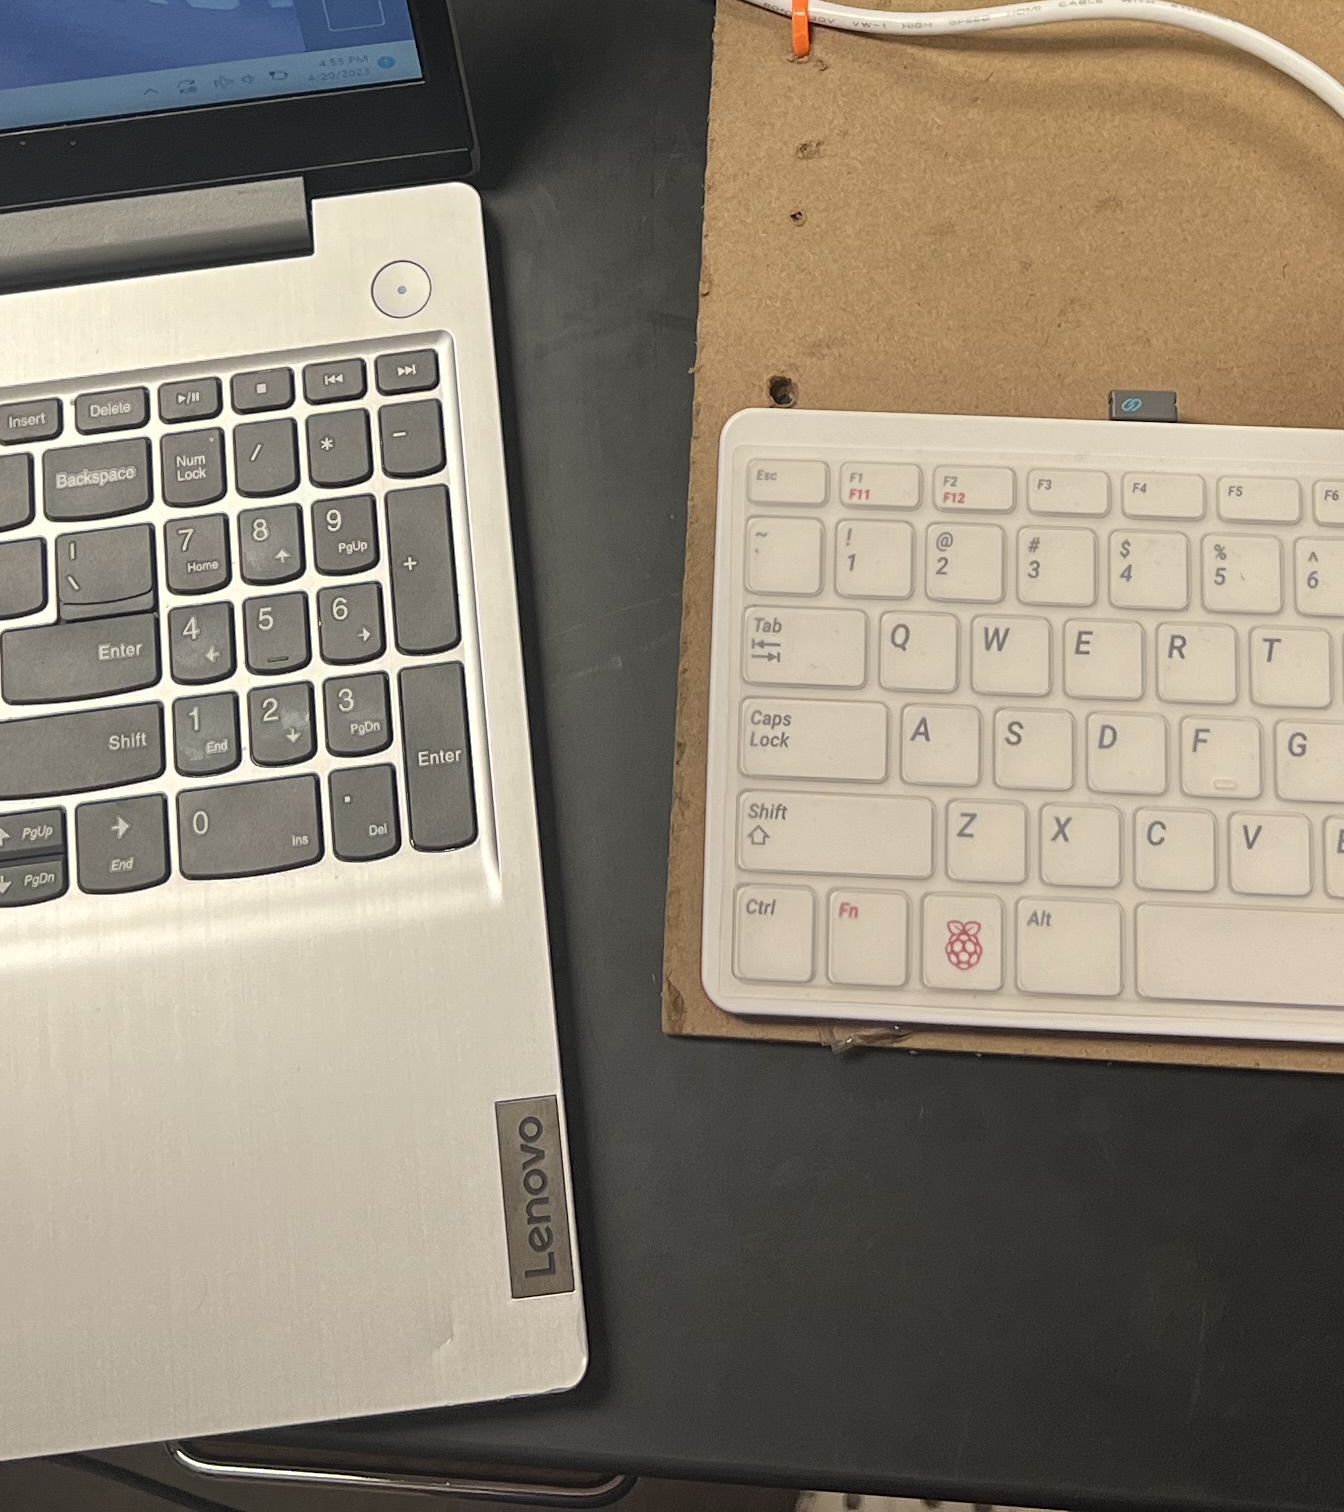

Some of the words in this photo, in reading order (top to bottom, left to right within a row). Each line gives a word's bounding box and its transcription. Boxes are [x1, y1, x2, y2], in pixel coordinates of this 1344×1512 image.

[348, 55, 369, 65] PM
[90, 402, 131, 417] Delete
[8, 412, 46, 429] Insert
[176, 455, 206, 468] Num
[55, 467, 135, 489] Backspace
[176, 466, 207, 482] Lock
[756, 468, 778, 481] Esc
[849, 471, 864, 484] F1
[942, 475, 958, 488] F2
[1037, 478, 1053, 491] F3
[1132, 482, 1147, 494] F4
[1227, 485, 1243, 497] F5
[848, 488, 871, 501] F11
[943, 491, 966, 504] F12
[1323, 489, 1340, 502] F6
[338, 540, 368, 555] PgUp
[187, 561, 219, 573] Home
[754, 617, 783, 634] Tab
[98, 643, 143, 661] Enter
[750, 709, 792, 730] Caps
[350, 720, 381, 736] PgDn
[109, 731, 147, 750] Shift
[206, 739, 228, 755] End
[749, 731, 790, 748] Lock
[417, 749, 462, 766] Enter
[748, 802, 788, 821] Shift
[22, 824, 53, 841] PgUp
[368, 823, 388, 836] Del
[292, 834, 309, 847] Ins
[110, 857, 134, 872] End
[24, 872, 55, 888] PgDn
[745, 898, 777, 916] Ctrl
[838, 902, 859, 919] Fn
[1026, 910, 1052, 927] Alt
[518, 1116, 557, 1278] Lenovo
